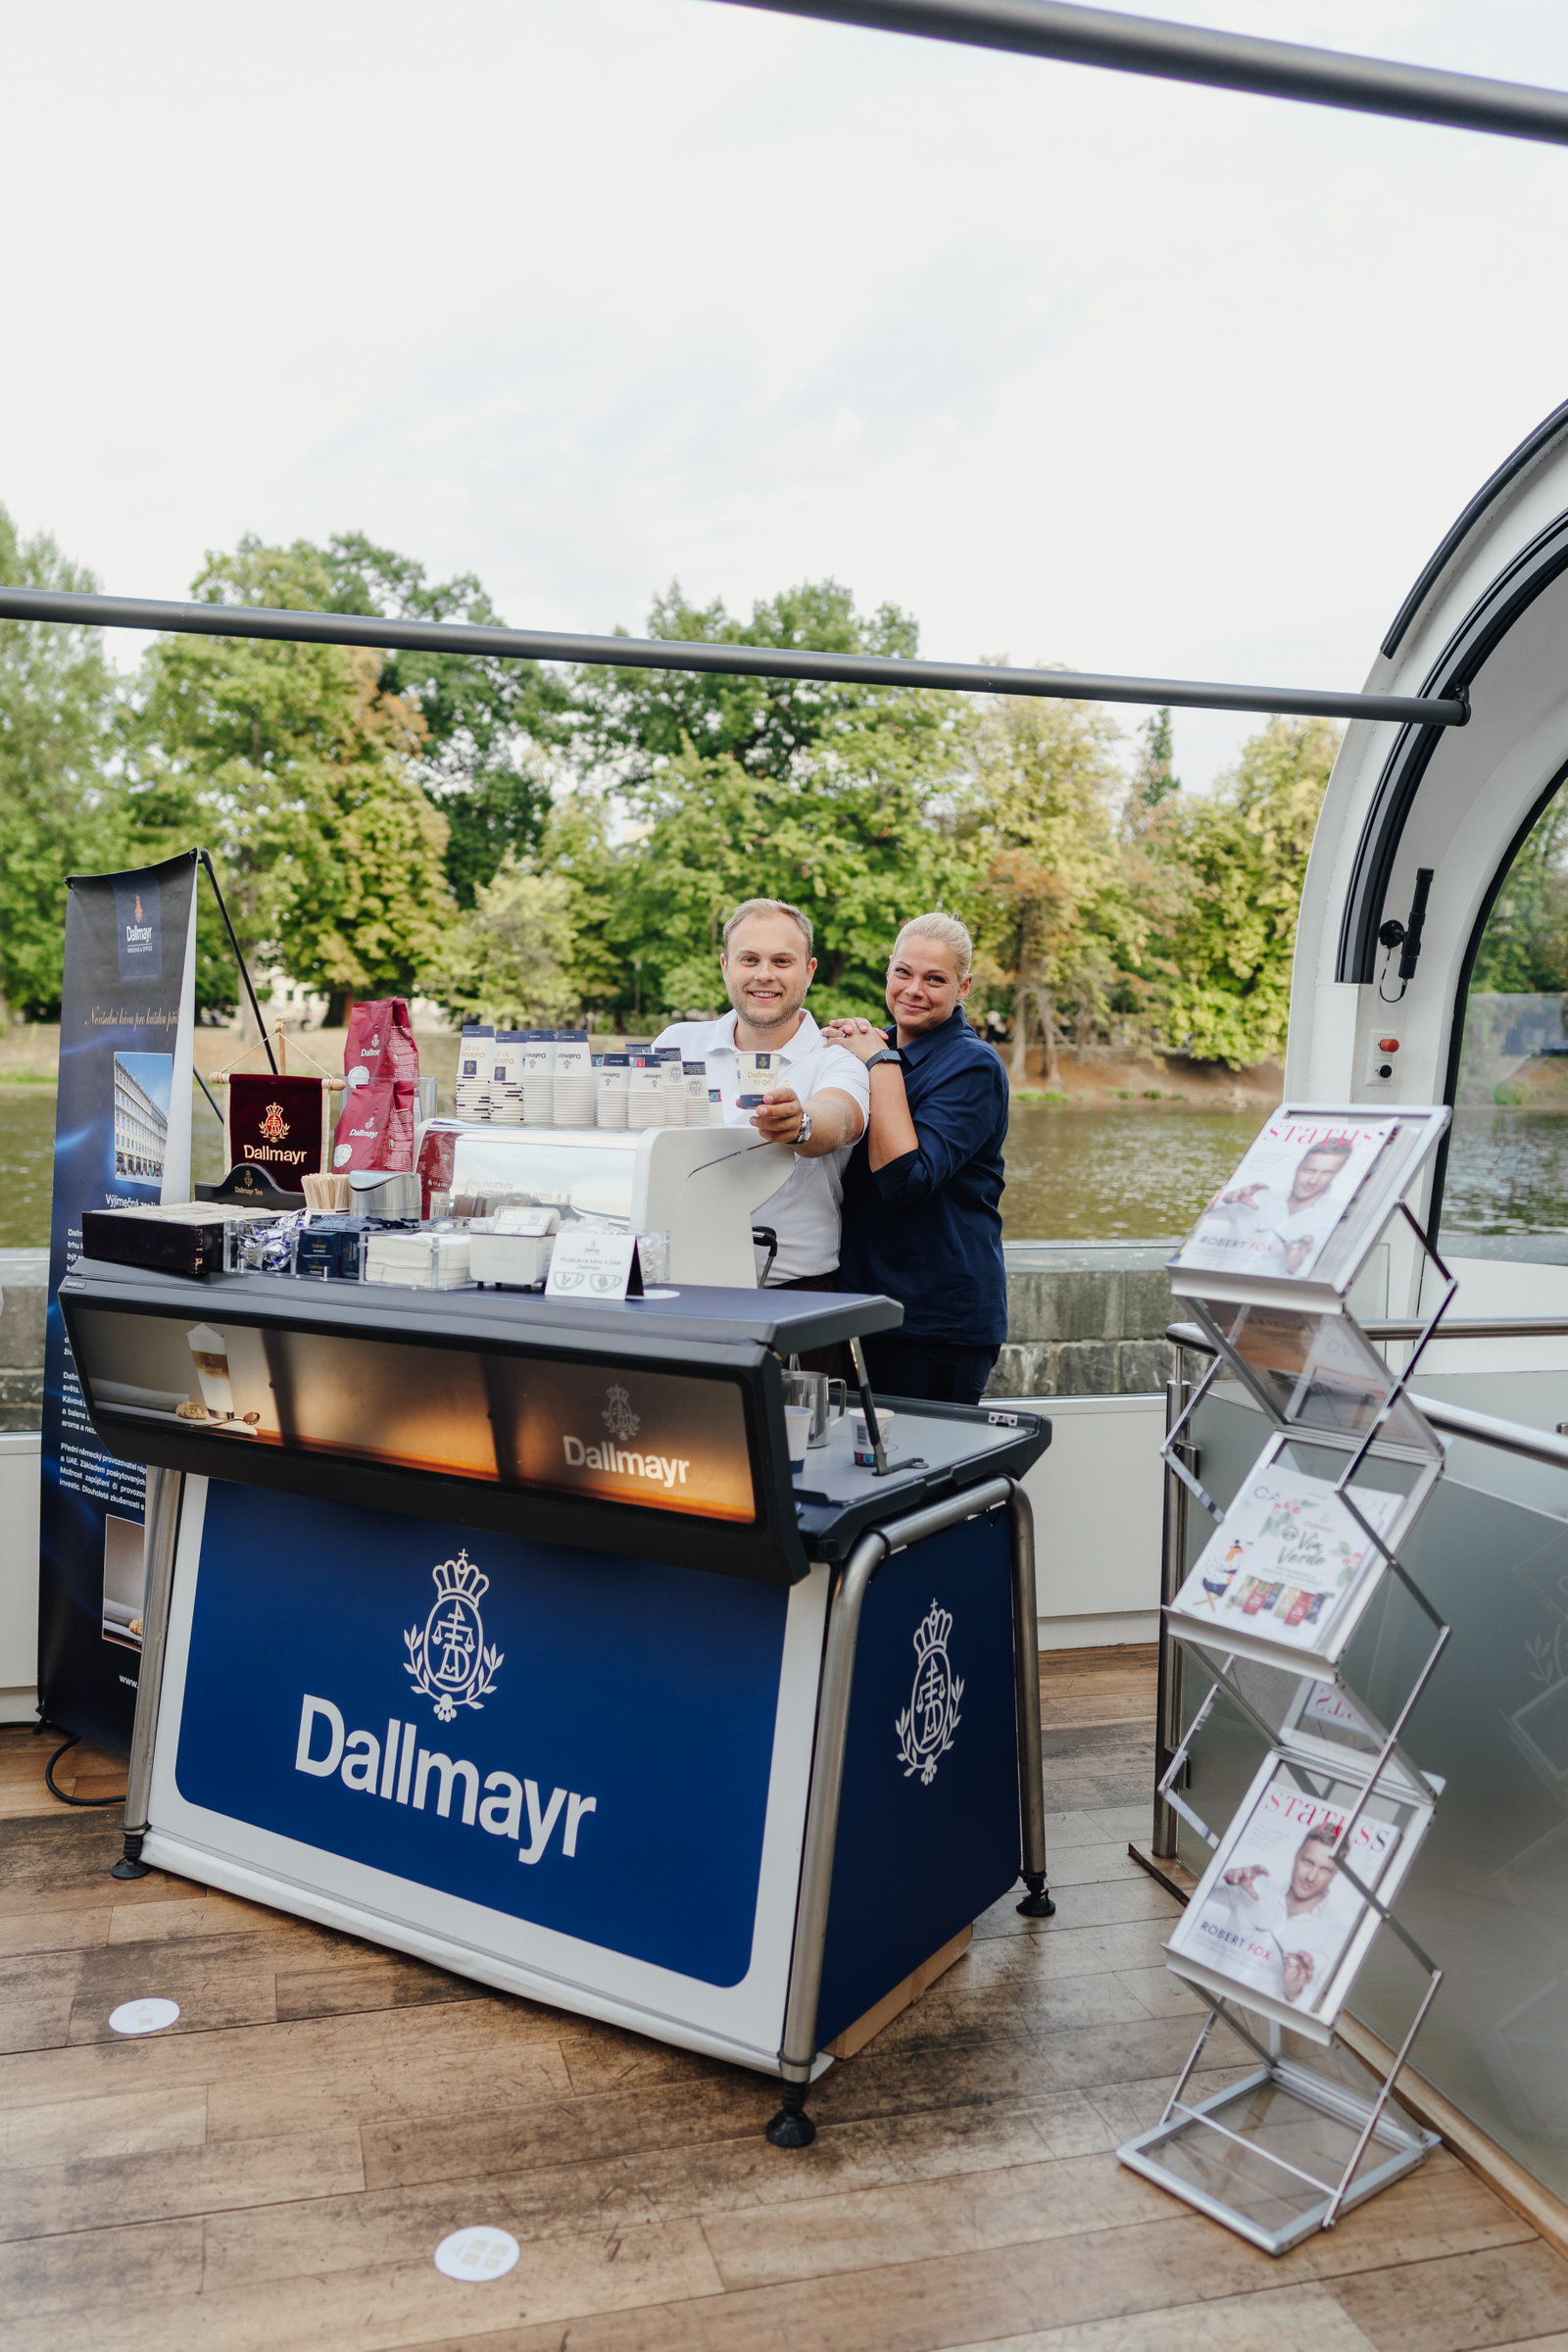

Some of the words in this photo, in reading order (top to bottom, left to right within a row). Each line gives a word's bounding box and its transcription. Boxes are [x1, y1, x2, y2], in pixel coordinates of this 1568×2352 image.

[126, 925, 153, 943] Dallmayr
[243, 1144, 308, 1165] Dallmayr
[564, 1436, 690, 1489] Dallmayr
[295, 1693, 598, 1865] Dallmayr
[1200, 1920, 1246, 1948] ROBERT
[1247, 1942, 1272, 1961] FOX
